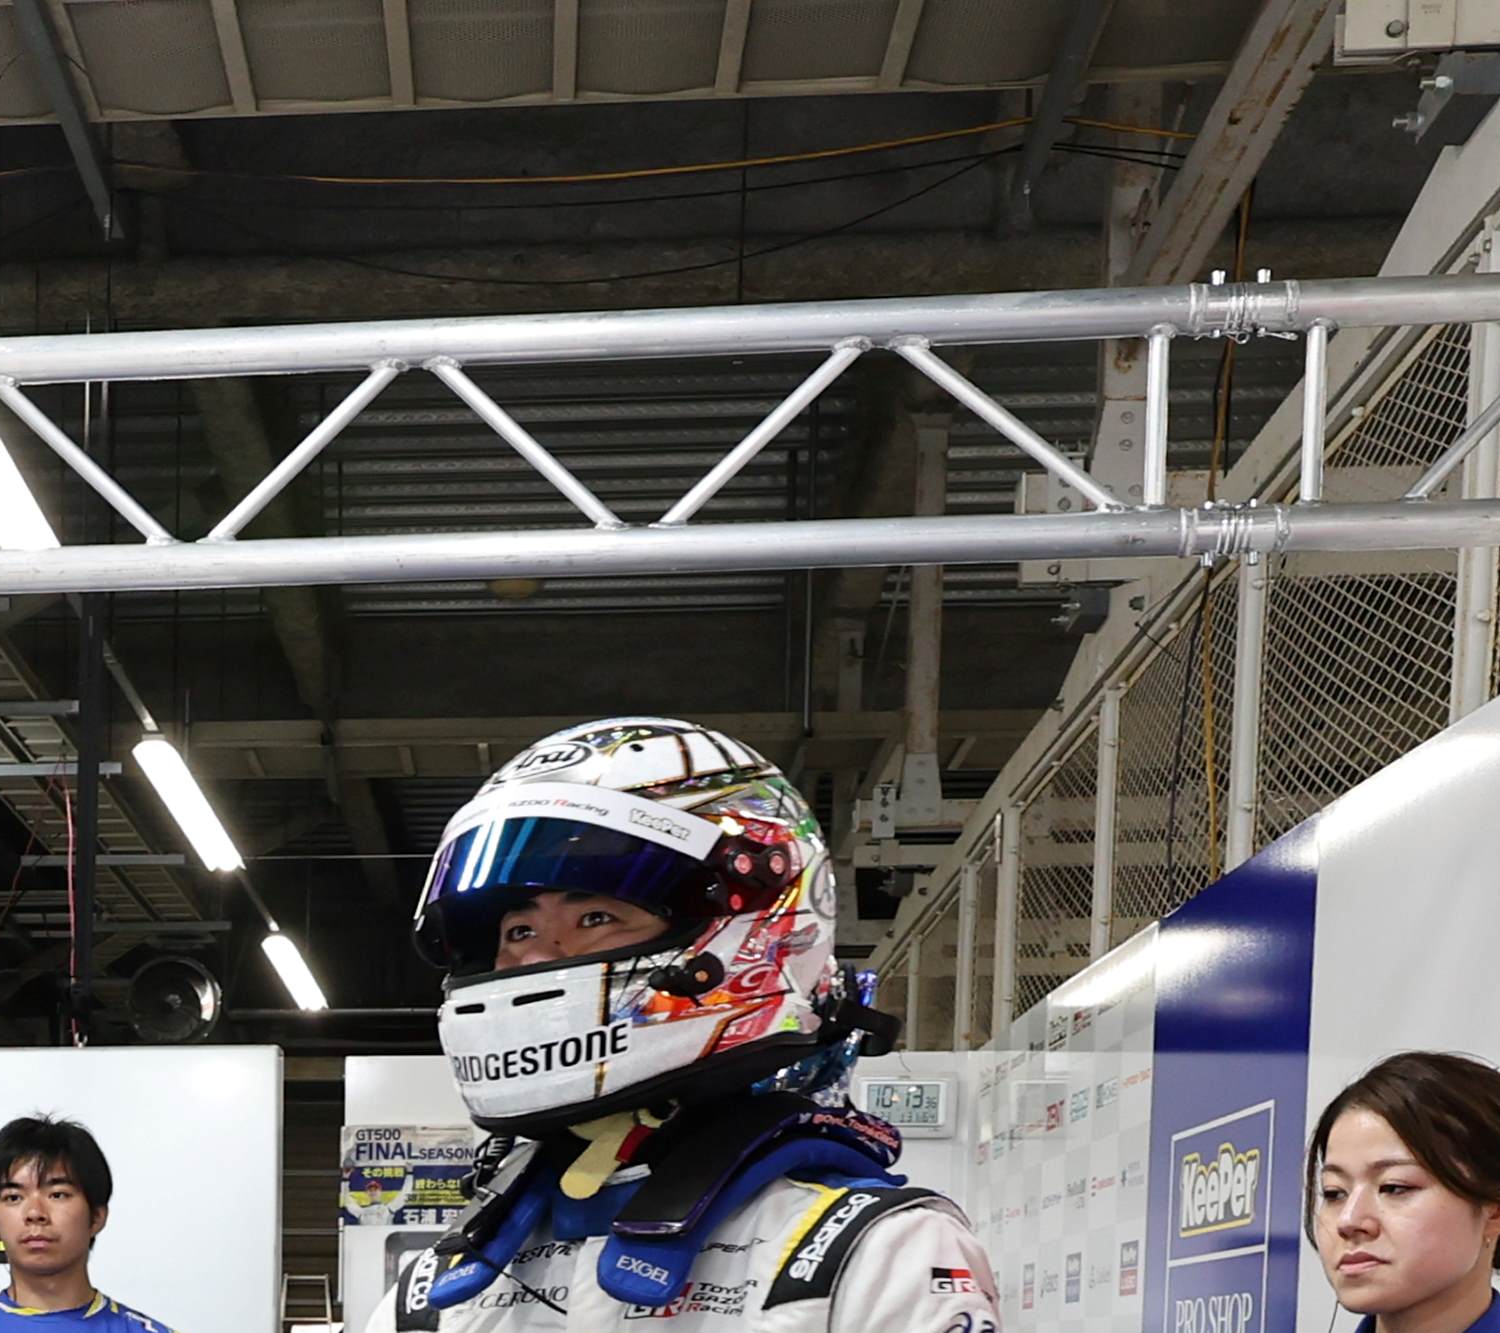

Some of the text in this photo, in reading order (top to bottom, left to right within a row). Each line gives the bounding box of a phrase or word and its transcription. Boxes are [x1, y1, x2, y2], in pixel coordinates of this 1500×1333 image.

[552, 798, 610, 817] Racing
[354, 1128, 402, 1142] GT500
[354, 1142, 476, 1161] FINAL SEASON
[1178, 1146, 1262, 1232] KeePer
[616, 1254, 673, 1287] EXGEL
[930, 1277, 977, 1294] GR
